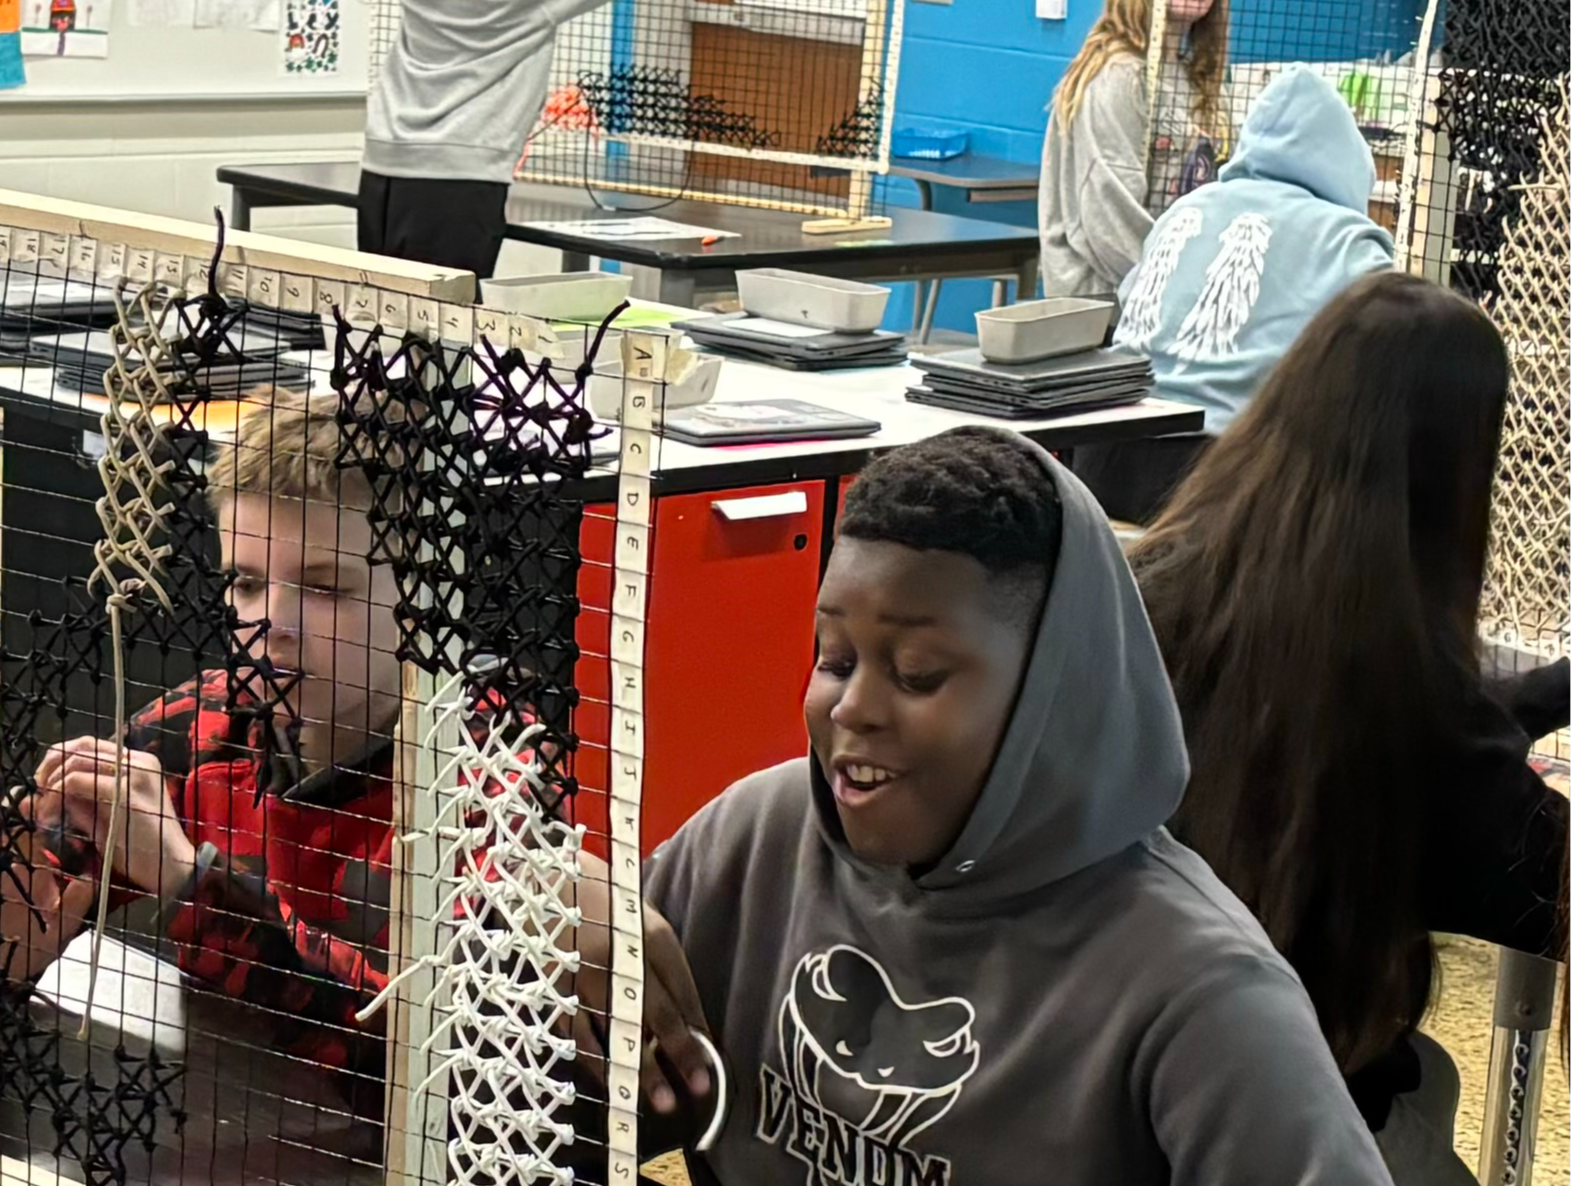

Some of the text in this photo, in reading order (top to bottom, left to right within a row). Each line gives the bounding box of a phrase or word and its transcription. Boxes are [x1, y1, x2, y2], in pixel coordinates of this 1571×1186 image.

[51, 236, 67, 255] 17
[80, 245, 93, 262] 16
[109, 243, 123, 265] 15
[137, 255, 149, 269] 14
[166, 260, 179, 274] 13
[260, 275, 273, 293] 10
[285, 287, 300, 299] 9
[319, 292, 333, 305] 8
[384, 305, 396, 314] 6
[417, 309, 430, 322] 5
[443, 318, 459, 329] 4
[477, 317, 496, 333] 3
[508, 325, 523, 338] 2
[633, 346, 653, 361] A
[632, 395, 646, 408] B
[630, 443, 642, 455] C
[626, 492, 639, 507] D
[626, 535, 639, 551] E
[624, 584, 637, 598] F
[622, 630, 635, 643] G
[624, 676, 637, 689] H
[624, 720, 636, 736] I
[623, 766, 637, 782] J
[624, 817, 634, 832] K
[625, 898, 638, 914] M
[626, 944, 640, 959] N
[623, 986, 637, 1001] O
[621, 1036, 636, 1053] P
[615, 1121, 630, 1137] R
[613, 1161, 630, 1180] S
